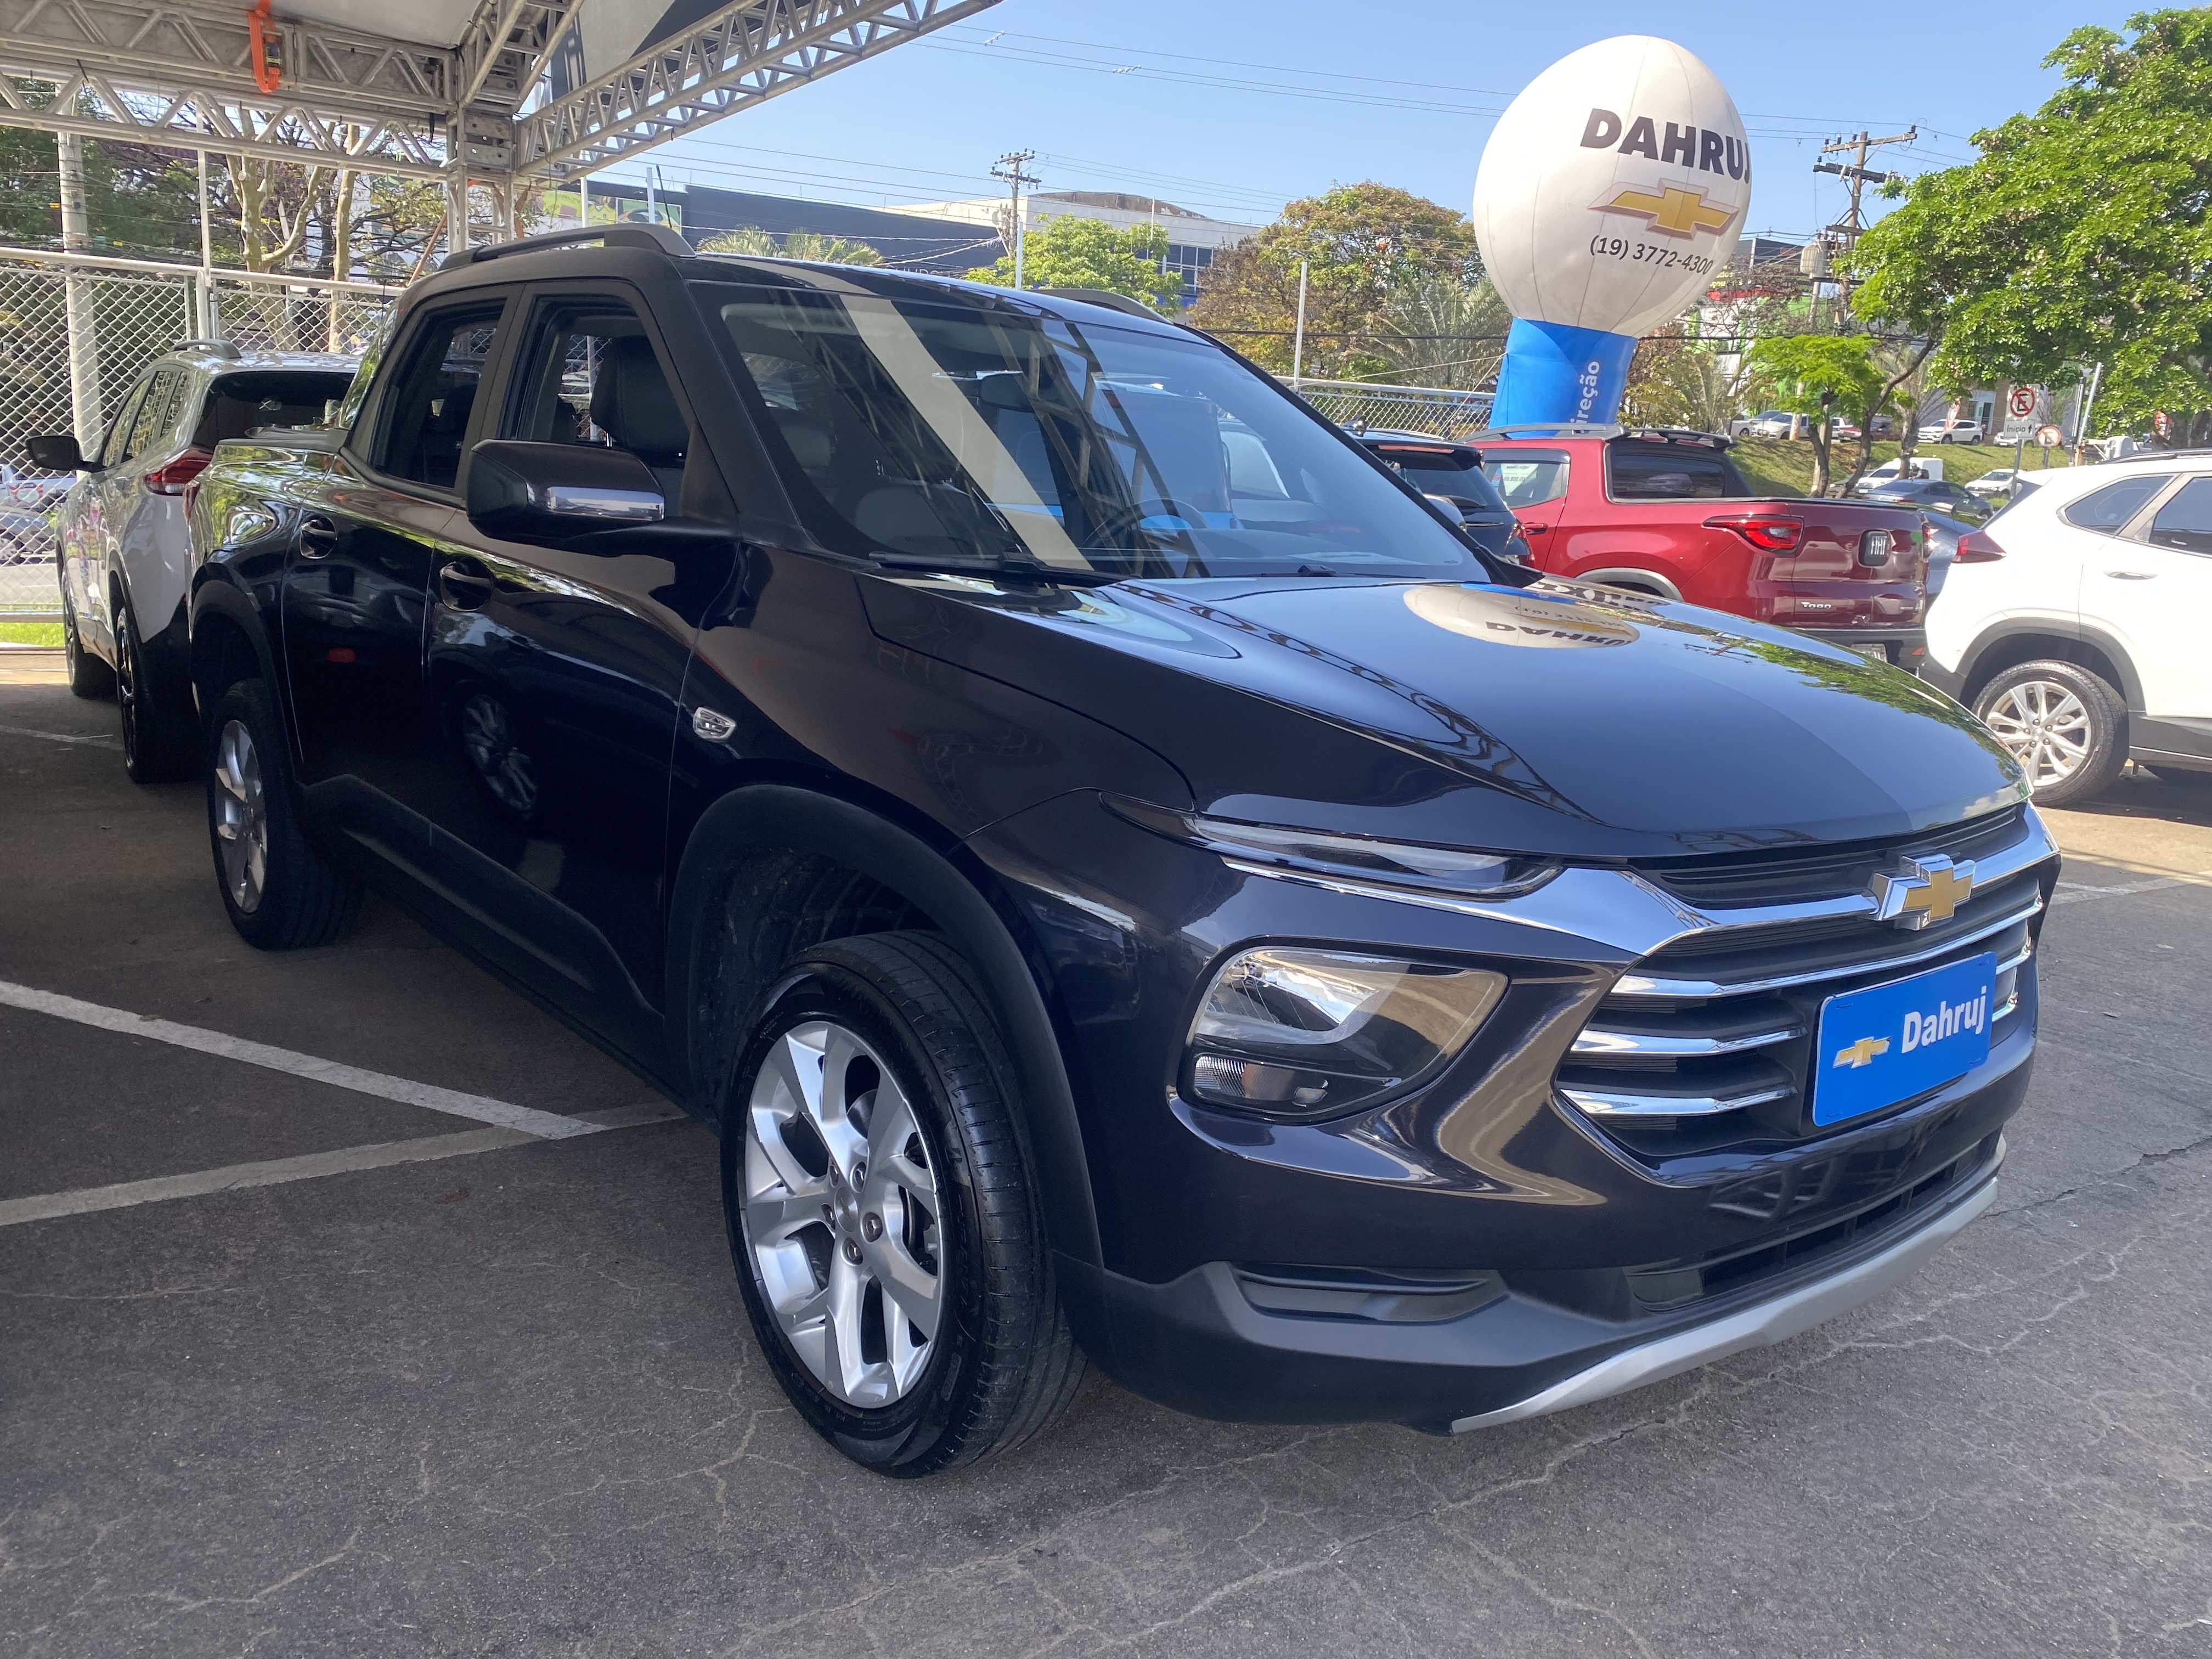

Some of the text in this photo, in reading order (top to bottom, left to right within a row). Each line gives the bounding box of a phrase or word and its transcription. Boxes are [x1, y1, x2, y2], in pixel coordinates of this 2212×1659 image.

[1580, 108, 1750, 184] DAHRUJ
[1590, 235, 1714, 275] (19) 3772-4300
[1570, 361, 1600, 424] ireção
[1870, 535, 1887, 555] FIAT
[1901, 985, 1987, 1054] Dahruj
